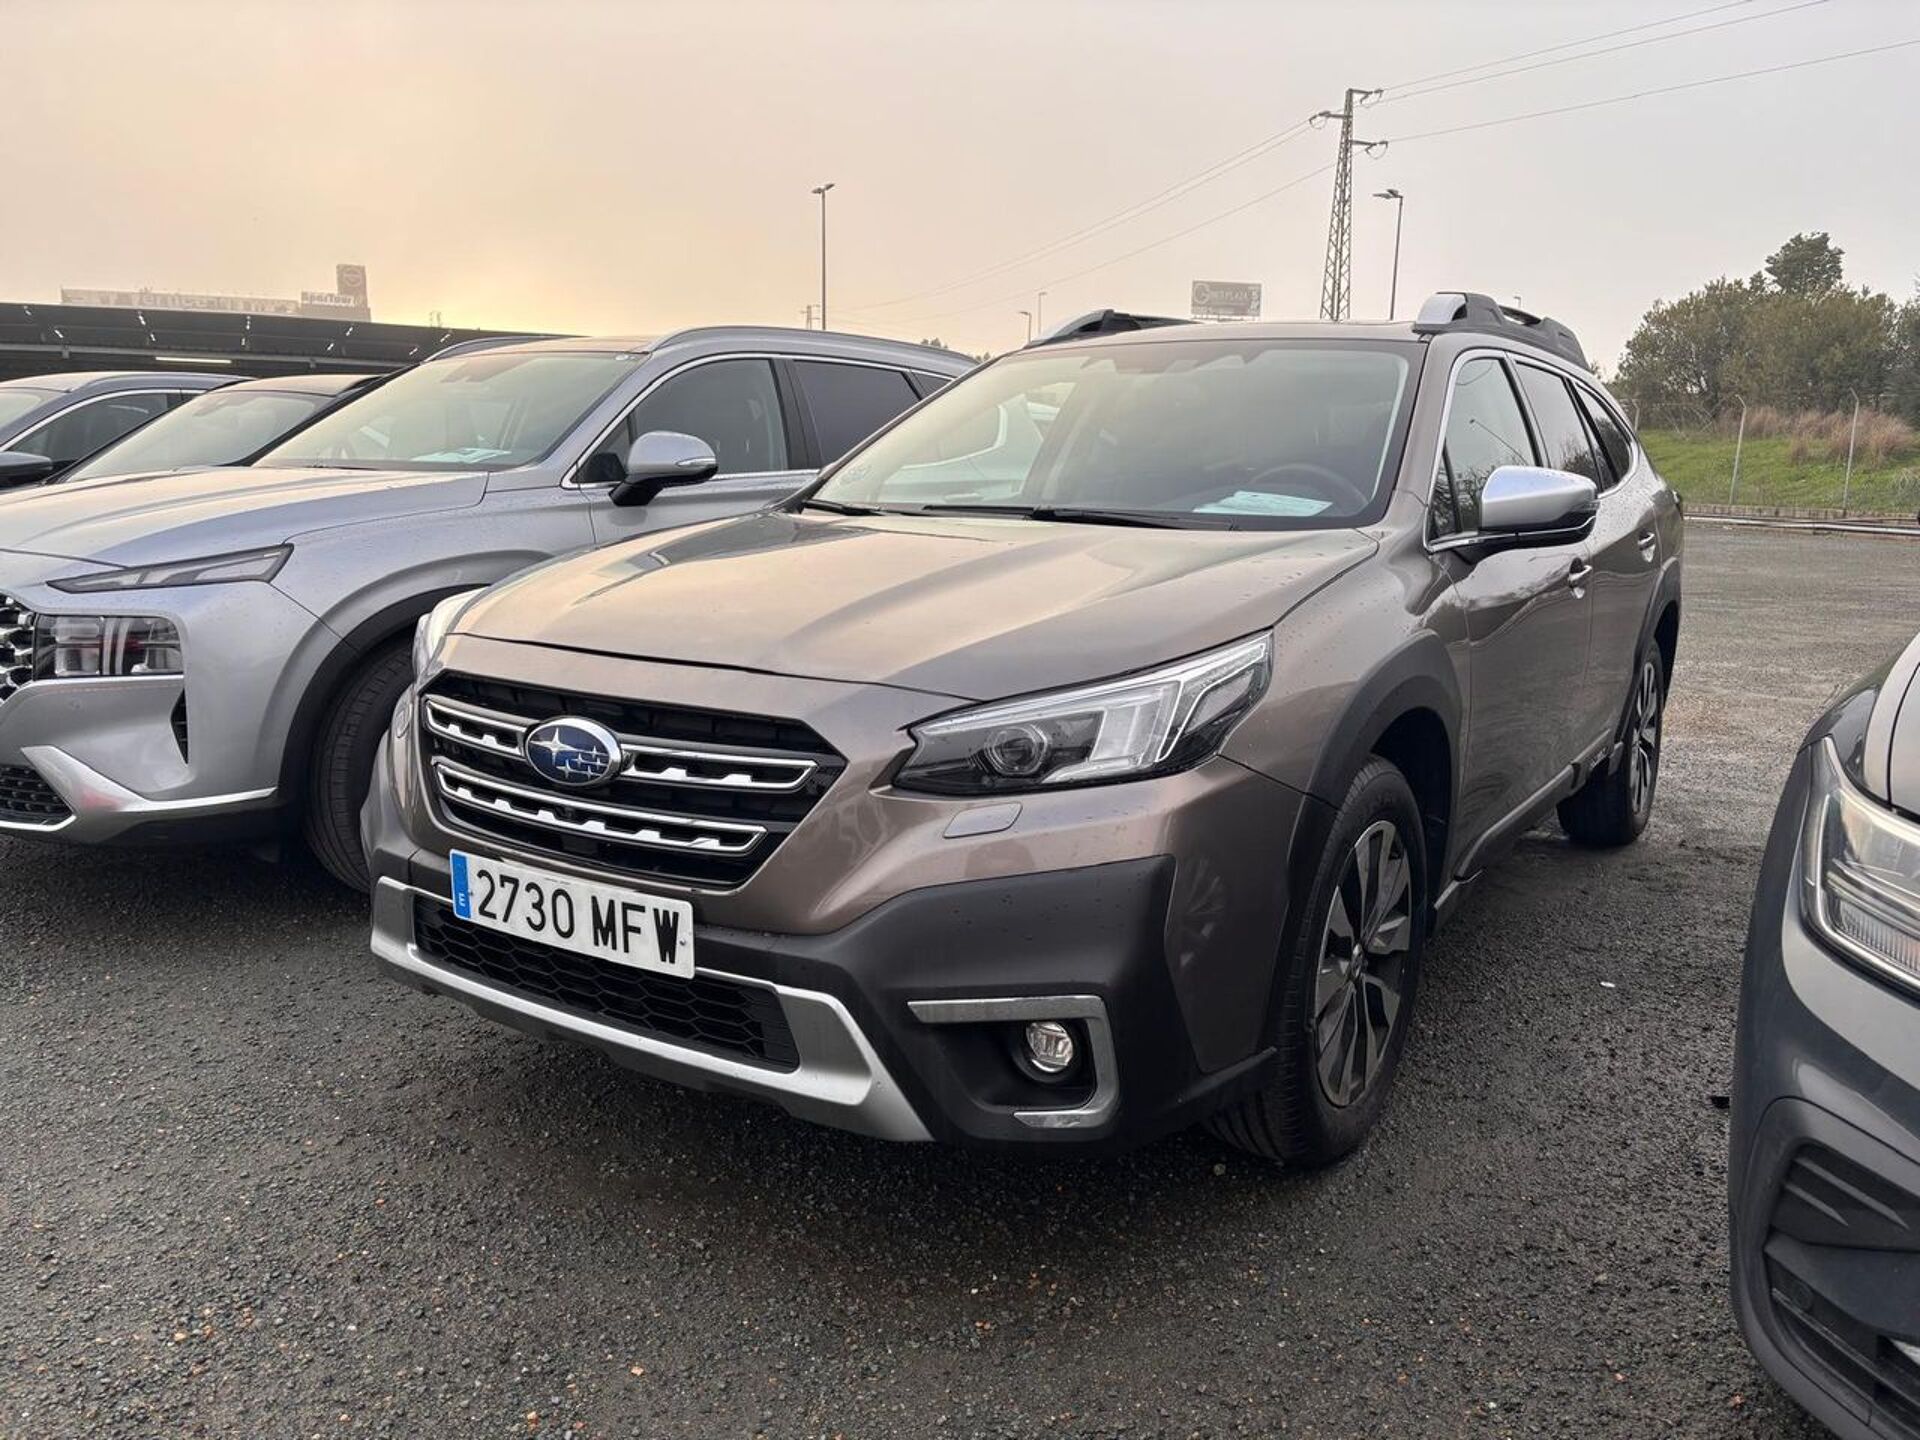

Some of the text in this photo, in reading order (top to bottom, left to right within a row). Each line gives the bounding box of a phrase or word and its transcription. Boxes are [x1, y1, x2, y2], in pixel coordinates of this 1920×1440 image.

[458, 893, 467, 907] E
[477, 869, 679, 965] 2730 MFW
